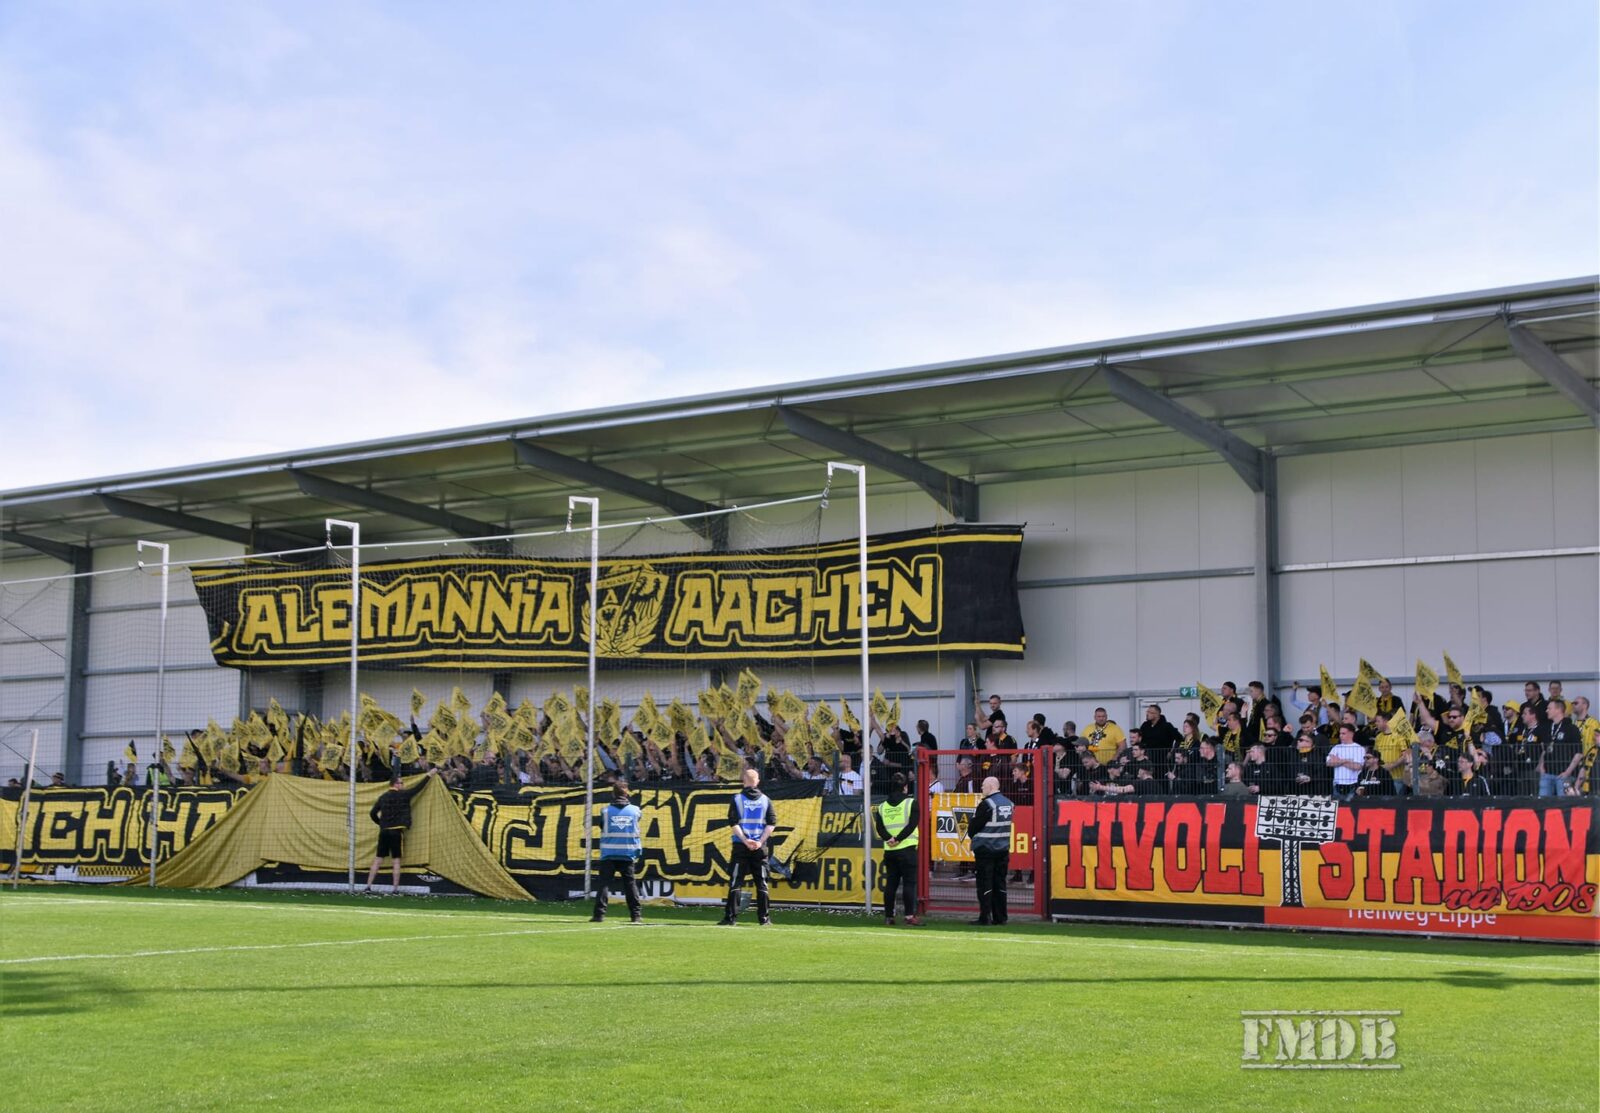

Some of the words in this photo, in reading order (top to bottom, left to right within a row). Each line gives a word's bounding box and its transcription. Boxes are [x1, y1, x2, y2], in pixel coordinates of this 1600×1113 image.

[672, 563, 935, 637] AACHEN
[1057, 799, 1264, 897] TIVOLI
[1318, 806, 1592, 905] STADION
[1506, 882, 1598, 913] 1908
